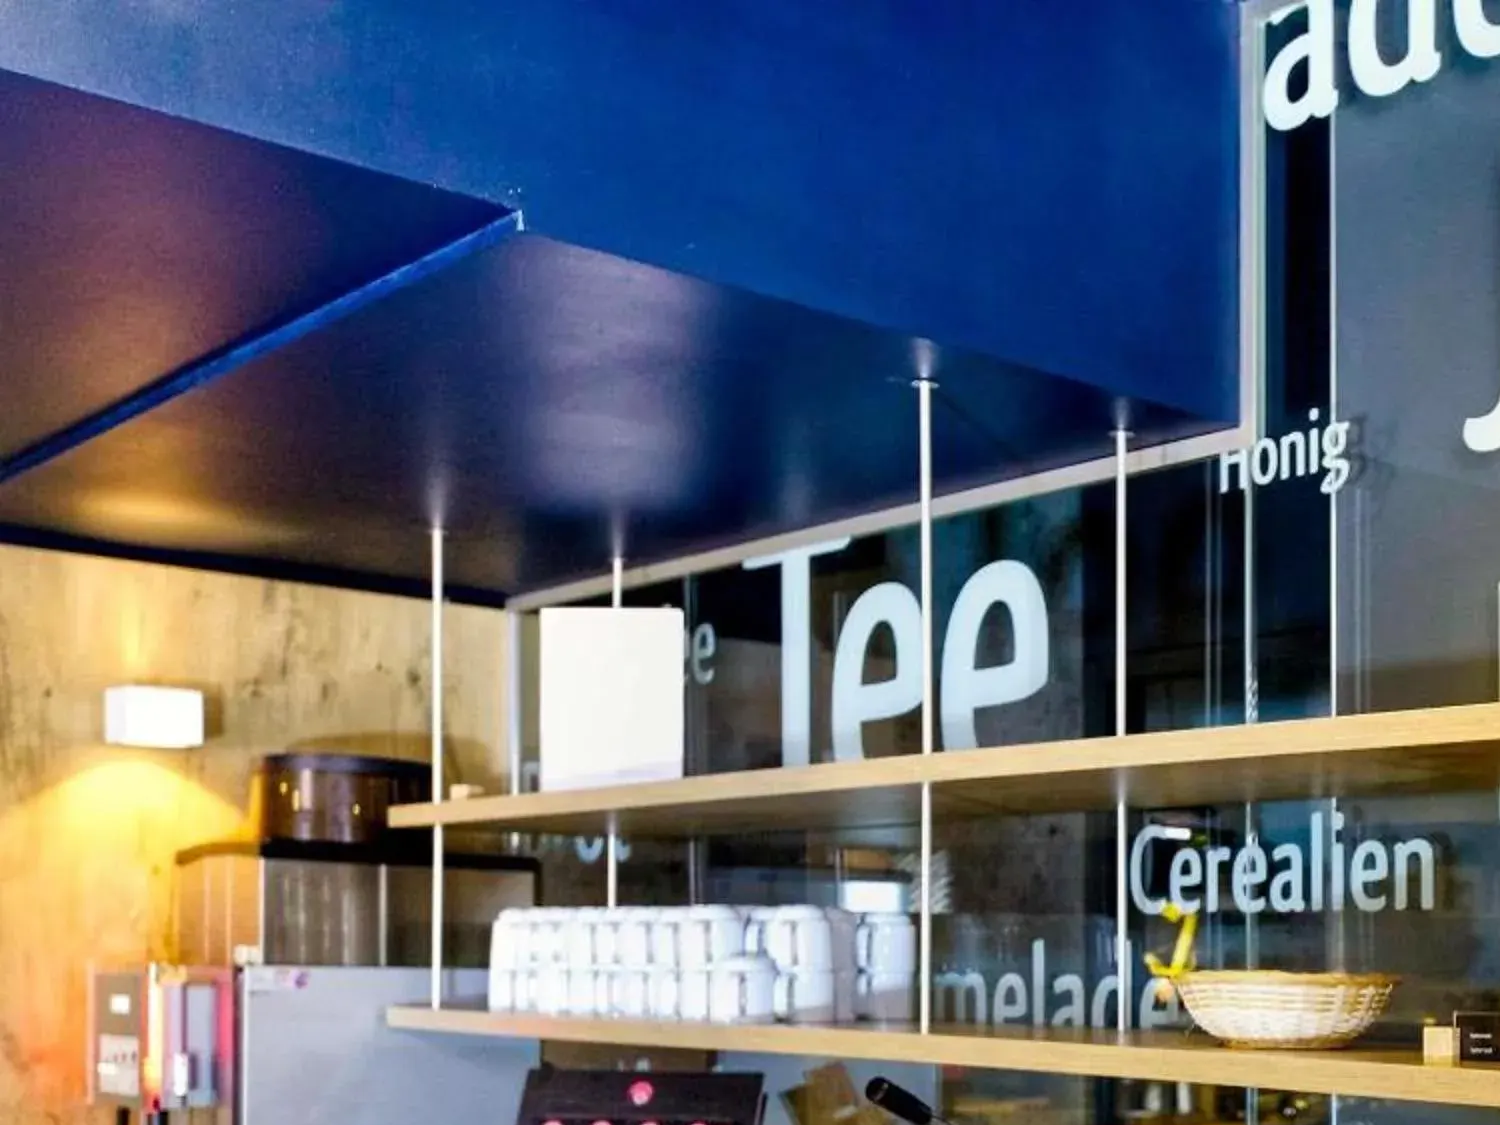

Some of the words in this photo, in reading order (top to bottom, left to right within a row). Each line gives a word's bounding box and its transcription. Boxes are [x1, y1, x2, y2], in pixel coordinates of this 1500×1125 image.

[1219, 407, 1350, 494] Honig
[742, 536, 1050, 768] Tee
[1130, 811, 1435, 915] Cerealien
